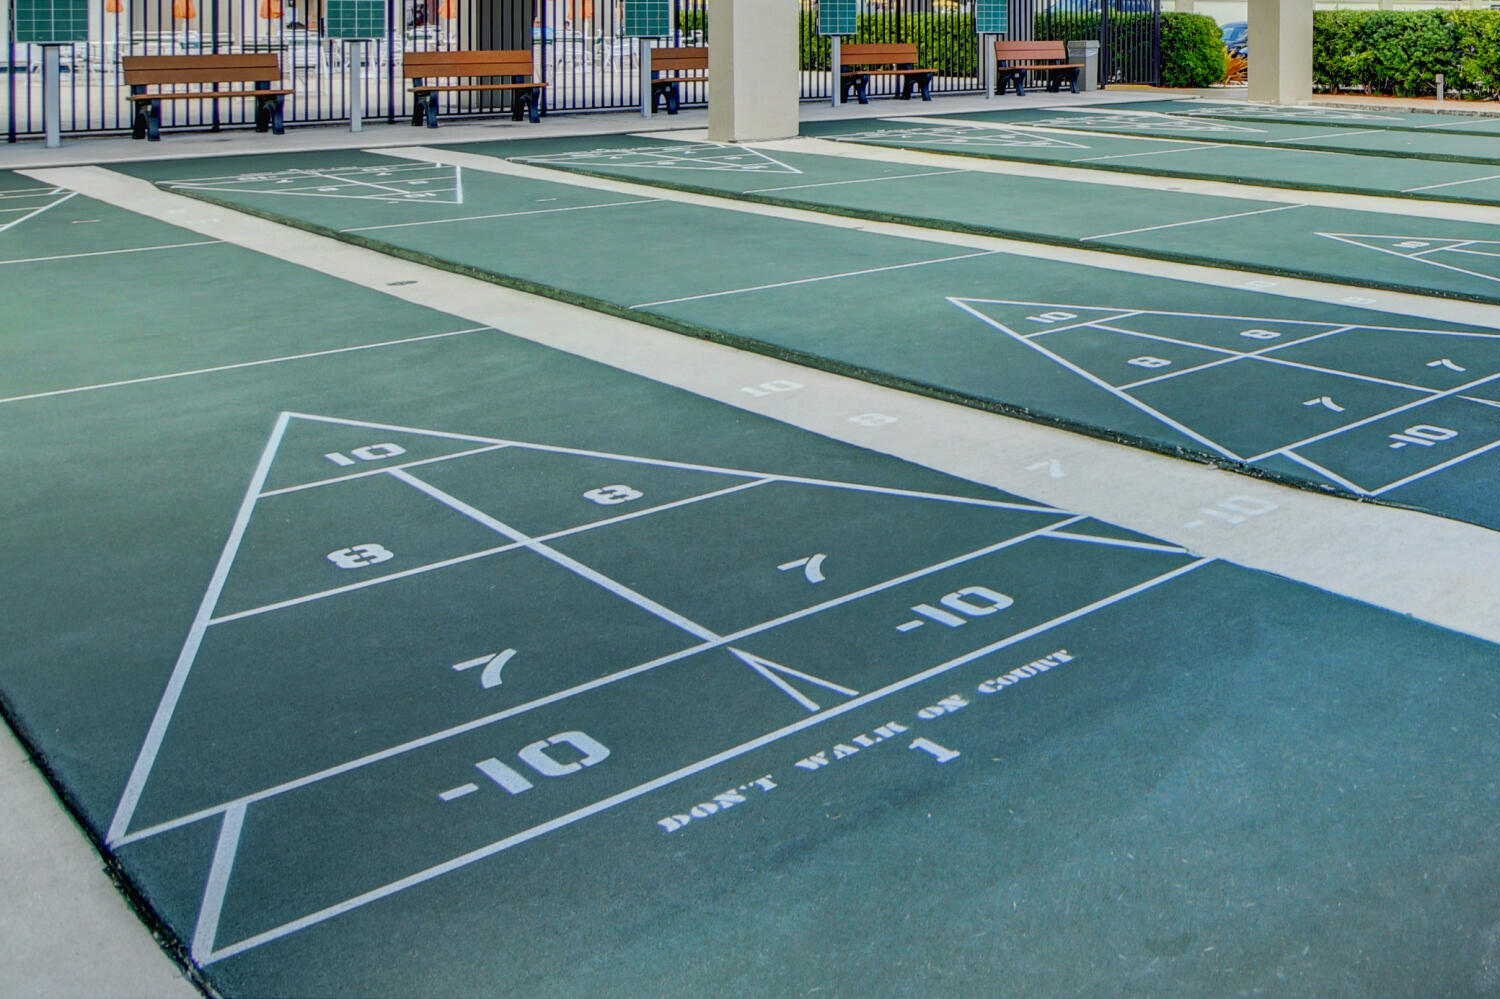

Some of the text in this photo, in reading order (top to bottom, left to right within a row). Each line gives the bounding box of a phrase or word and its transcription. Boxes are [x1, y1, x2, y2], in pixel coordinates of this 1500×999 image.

[1025, 311, 1079, 325] 10
[1239, 328, 1281, 341] 8
[1127, 355, 1172, 369] 8
[1425, 358, 1467, 373] 7
[1302, 396, 1345, 412] 7
[1388, 424, 1459, 450] -10
[323, 441, 407, 468] 10
[1024, 458, 1065, 479] 7
[582, 484, 644, 505] 8
[326, 543, 394, 570] 8
[776, 553, 827, 585] 7
[895, 585, 1015, 634] -10
[452, 647, 518, 690] 7
[656, 648, 1076, 834] DON'T WALK ON COURT
[907, 736, 962, 763] 1
[438, 730, 611, 802] -10
